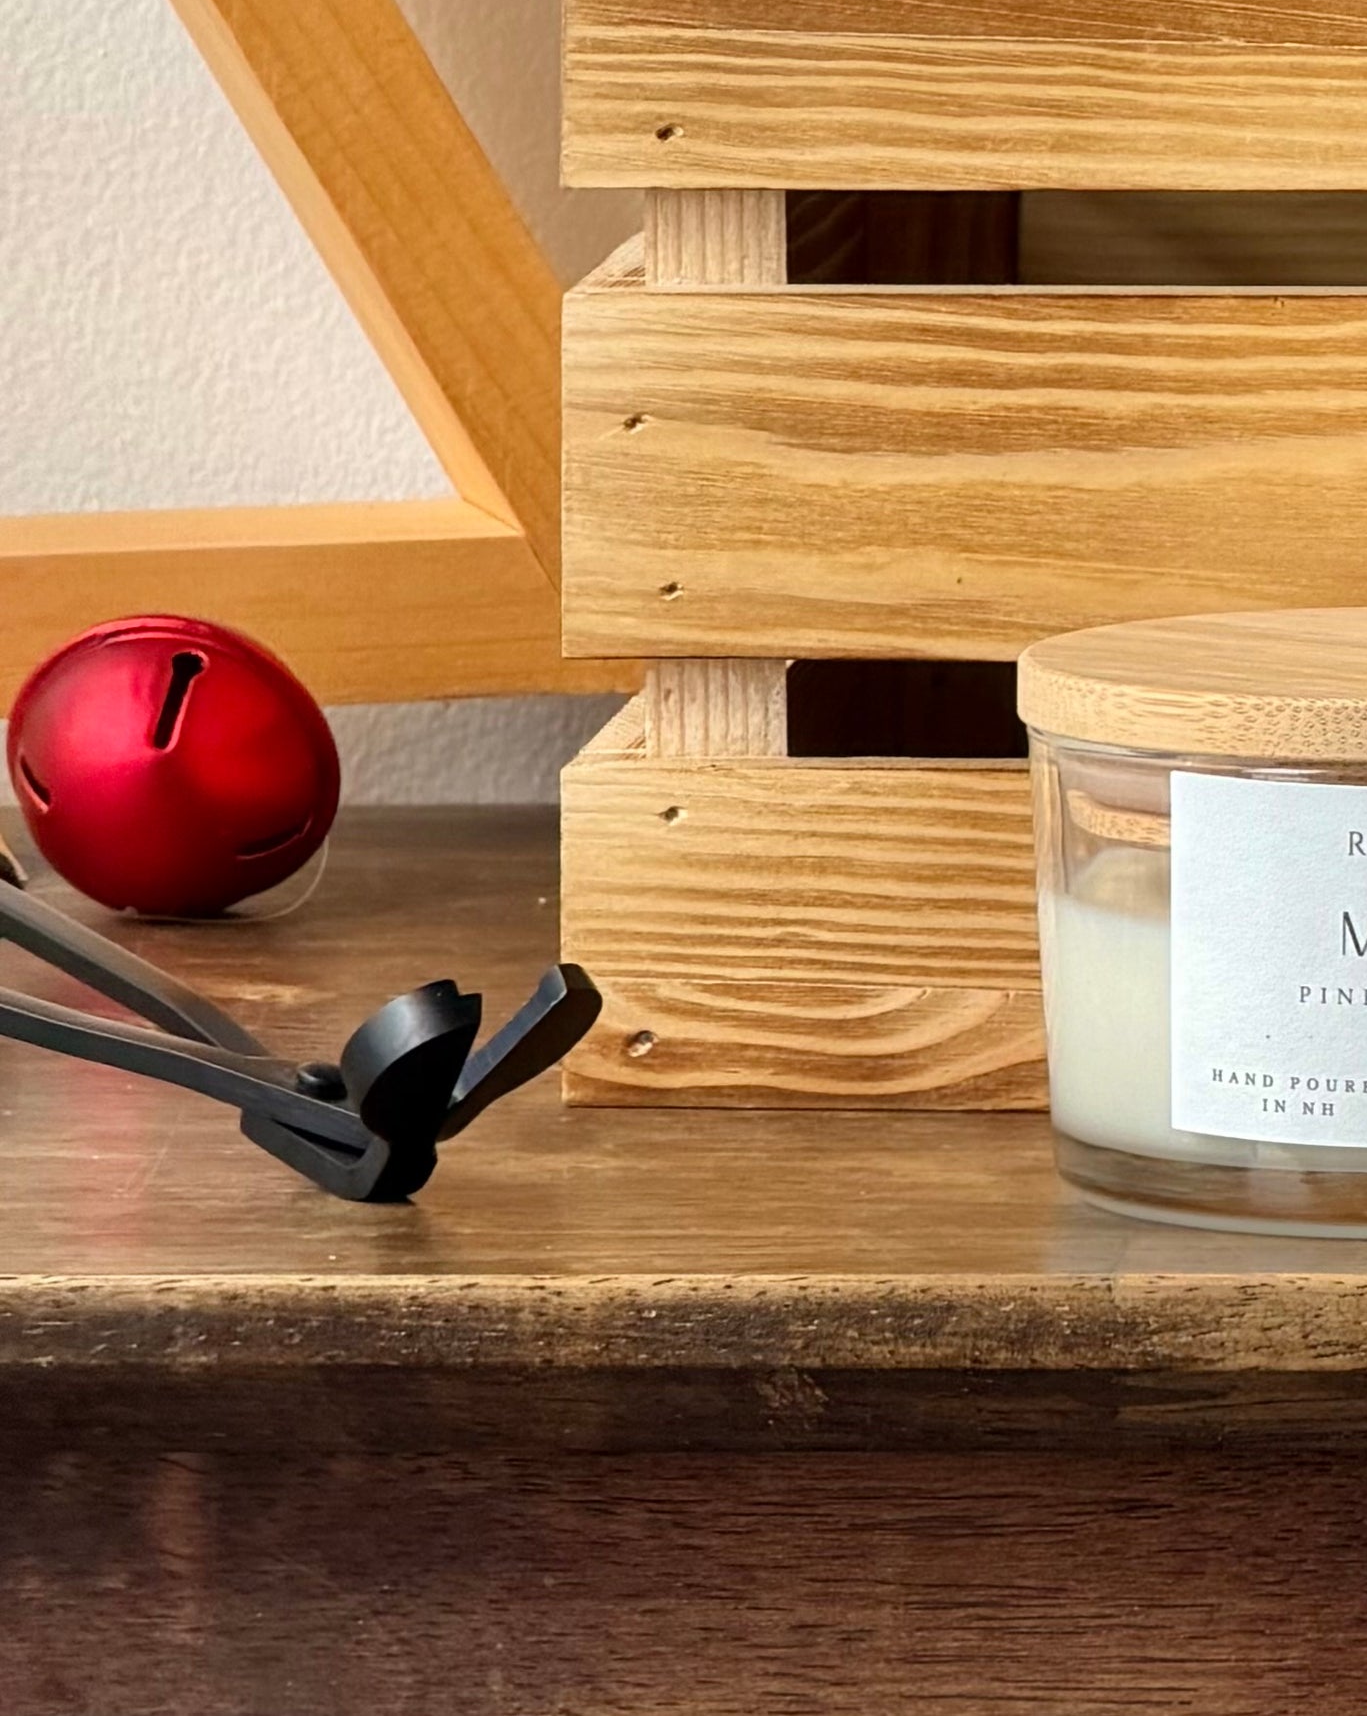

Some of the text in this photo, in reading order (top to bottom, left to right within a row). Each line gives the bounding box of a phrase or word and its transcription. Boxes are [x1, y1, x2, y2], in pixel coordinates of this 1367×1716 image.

[1212, 1068, 1274, 1088] HAND
[1262, 1098, 1335, 1117] IN NH
